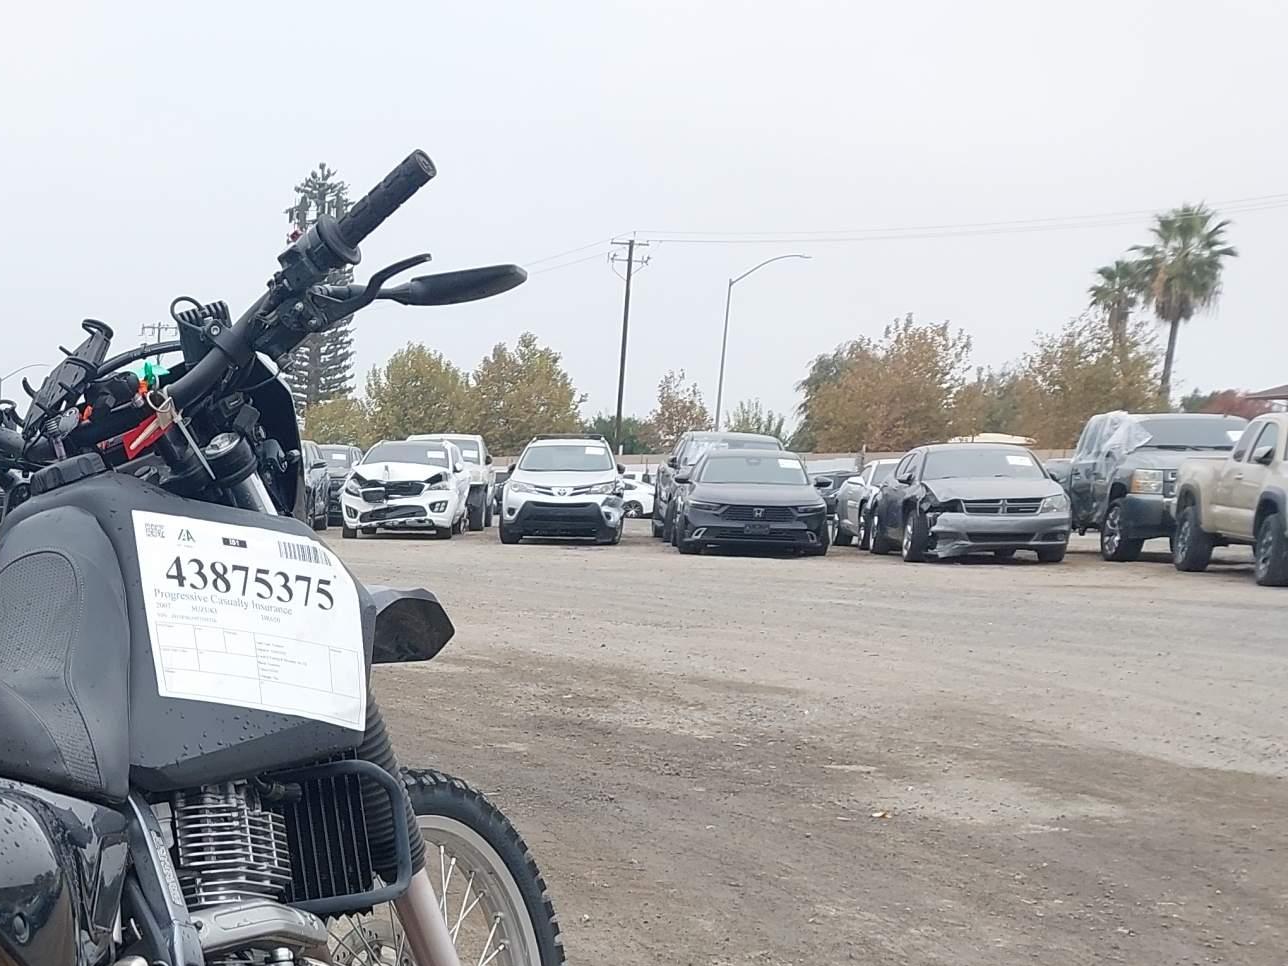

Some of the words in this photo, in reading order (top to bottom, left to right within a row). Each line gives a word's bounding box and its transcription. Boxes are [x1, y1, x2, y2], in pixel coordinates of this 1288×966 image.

[154, 588, 209, 602] Progressive
[210, 594, 249, 610] Casualty
[251, 600, 293, 616] Insurance
[165, 556, 335, 611] 43875375
